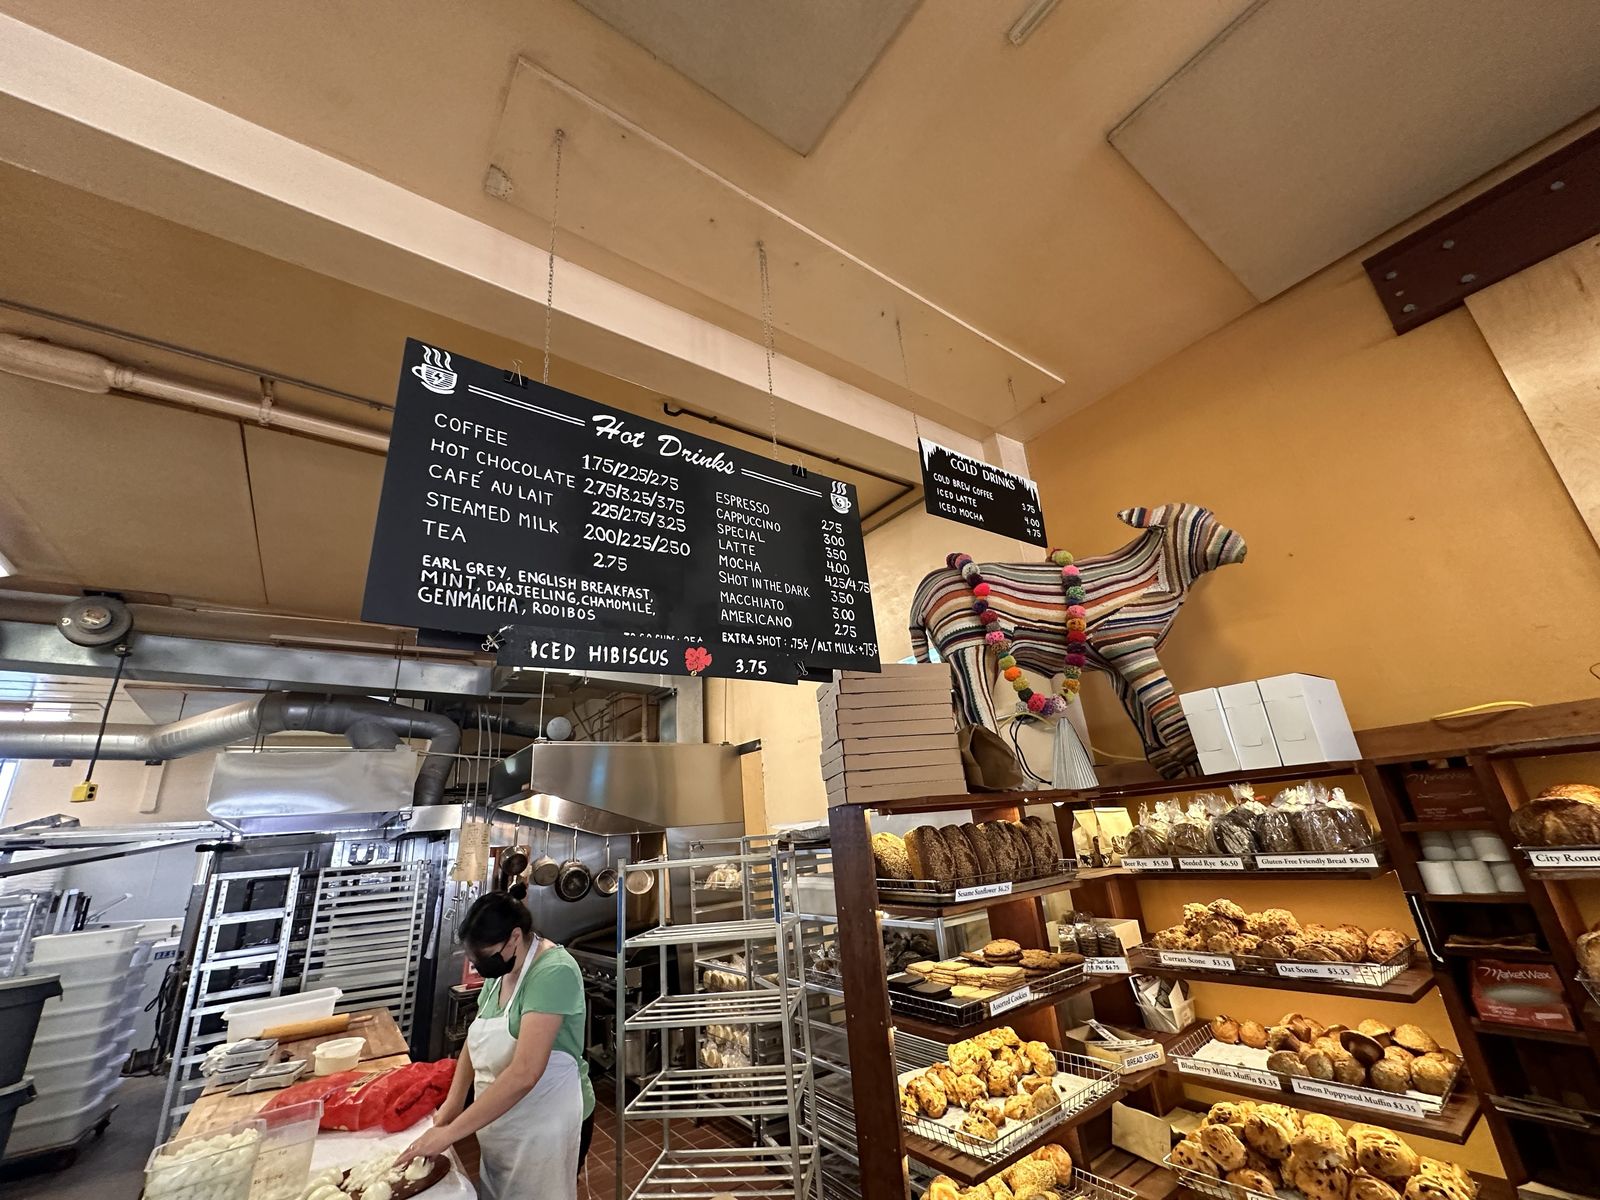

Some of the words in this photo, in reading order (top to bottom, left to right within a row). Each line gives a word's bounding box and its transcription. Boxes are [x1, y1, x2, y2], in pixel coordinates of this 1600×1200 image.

[434, 413, 508, 447] COFFEE
[592, 414, 646, 448] Hot
[658, 434, 735, 475] Drinks
[428, 464, 484, 489] CAFÉ
[491, 479, 512, 496] AU
[518, 485, 554, 506] LAIT
[430, 438, 469, 460] HOT
[476, 451, 576, 489] CHOCOLATE
[583, 478, 685, 515] 2.75/3.25/3.75
[933, 472, 951, 485] COLD
[952, 478, 970, 492] BREW
[972, 486, 994, 501] COFFEE
[950, 458, 978, 476] COLD
[982, 469, 1016, 491] DRINKS
[715, 491, 770, 515] ESPRESSO
[936, 487, 954, 500] ICED
[955, 493, 977, 508] LATTE
[426, 491, 511, 524] STEAMED
[519, 512, 560, 534] MILK
[716, 508, 781, 532] CAPPUCCINO
[939, 501, 957, 514] ICED
[959, 507, 984, 522] MOCHA
[717, 523, 766, 543] SPECIAL
[422, 519, 467, 543] TEA
[593, 552, 628, 572] 2.75
[718, 539, 756, 556] LATTE
[826, 560, 850, 575] 4.00
[718, 554, 762, 573] MOCHA
[420, 569, 481, 592] MINT,
[422, 554, 462, 572] EARL
[466, 561, 512, 582] GREY,
[518, 570, 577, 590] ENGLISH
[580, 580, 654, 603] BREAKFAST,
[718, 570, 748, 587] SHOT
[785, 583, 811, 598] DARK
[532, 602, 596, 621] ROOIBOS
[720, 591, 785, 611] MACCHIATO
[832, 607, 856, 622] 3.00
[720, 608, 793, 628] AMERICANO
[721, 631, 754, 646] EXTRA
[530, 640, 576, 662] ICED
[588, 645, 669, 667] HIBISCUS
[1181, 859, 1203, 867] Seeded
[1299, 858, 1326, 866] Friendly
[1535, 854, 1560, 865] City
[957, 889, 974, 898] Sesame
[974, 886, 997, 896] Sunflower
[1162, 954, 1187, 963] Currant
[1188, 957, 1206, 965] Scone
[1212, 959, 1231, 967] $3.35
[1280, 965, 1294, 973] Oat
[1295, 966, 1319, 974] Scone
[1327, 967, 1350, 976] $3.35
[992, 996, 1012, 1013] Assorted
[1011, 990, 1028, 1006] Cookies
[1126, 1056, 1144, 1067] BREAD
[1144, 1051, 1159, 1062] SIGNS
[1180, 1061, 1211, 1074] Blueberry
[1212, 1067, 1232, 1078] Millet
[1233, 1071, 1257, 1083] Muffin
[1257, 1077, 1278, 1088] $3.35
[1297, 1081, 1322, 1094] Lemon
[1323, 1087, 1363, 1102] Poppyseed
[1364, 1096, 1392, 1108] Muffin
[1392, 1102, 1416, 1113] $3.35
